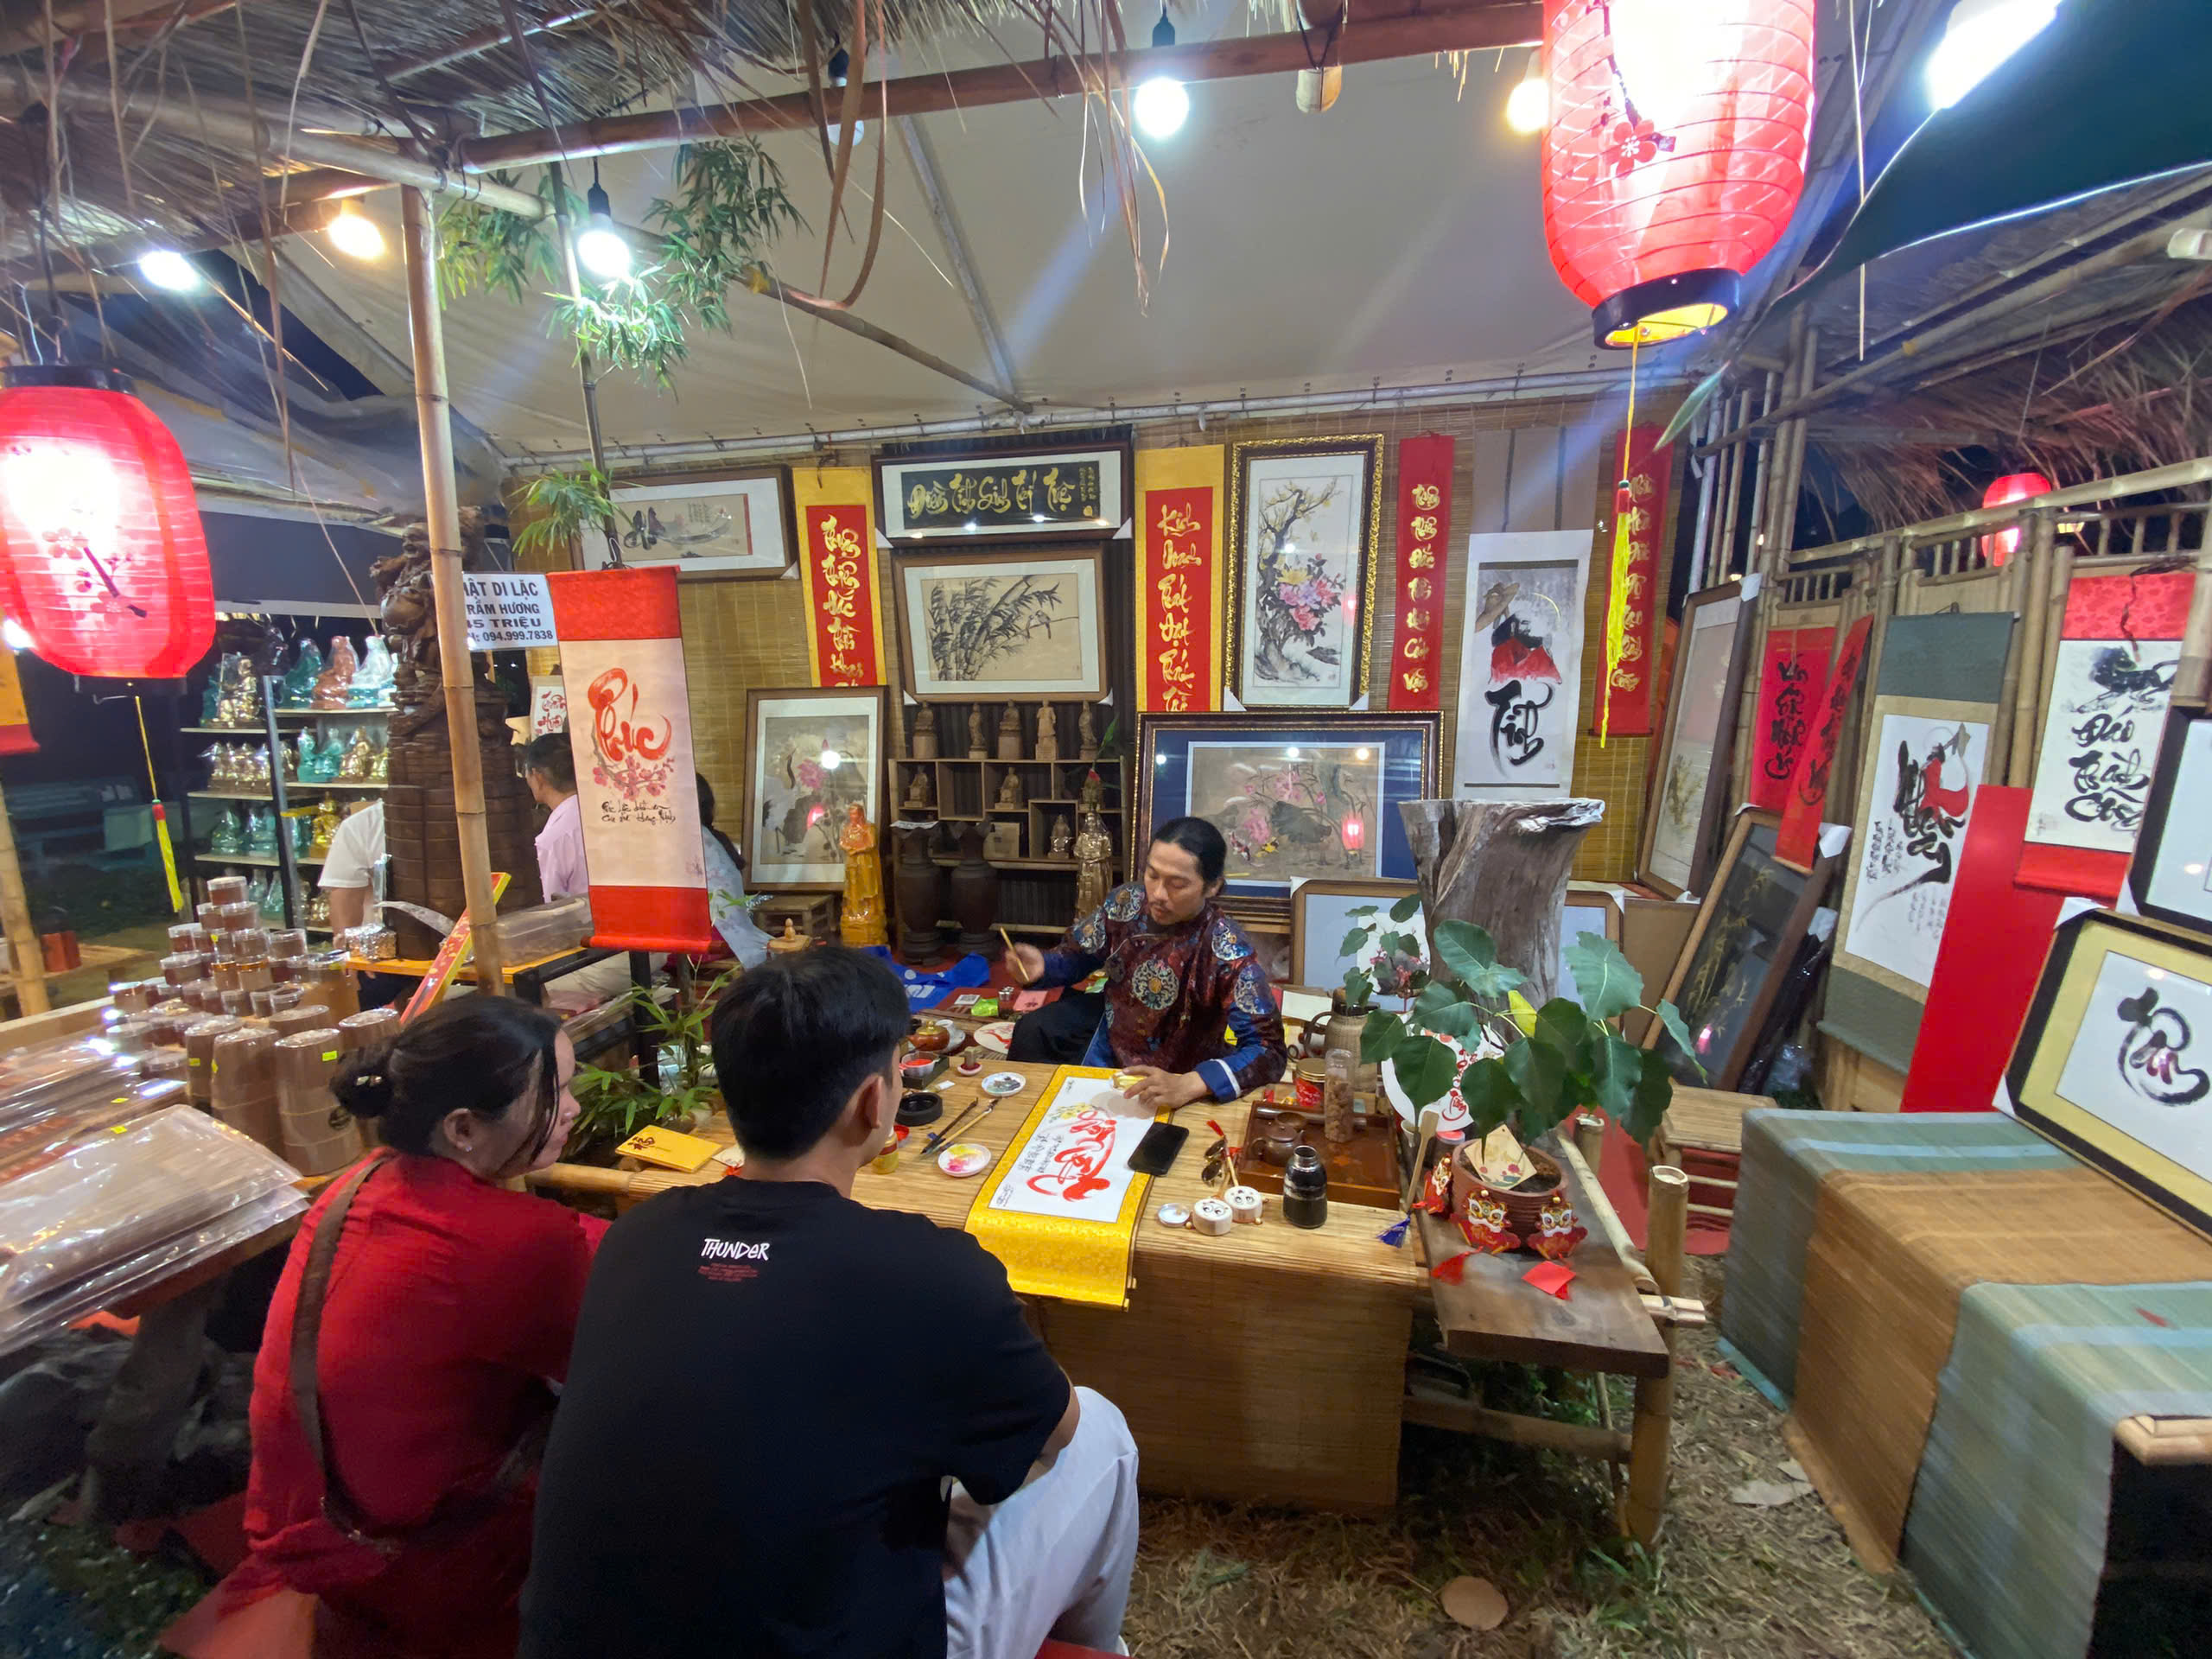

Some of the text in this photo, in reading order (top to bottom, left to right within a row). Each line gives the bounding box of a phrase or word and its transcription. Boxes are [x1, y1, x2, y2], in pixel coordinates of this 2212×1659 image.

[463, 578, 486, 599] ẬT
[492, 582, 508, 596] DI
[467, 600, 540, 614] RẦM HƯƠNG
[489, 616, 541, 629] TRIỆU
[482, 630, 553, 642] 094.999.7838
[588, 668, 672, 763] Phúc
